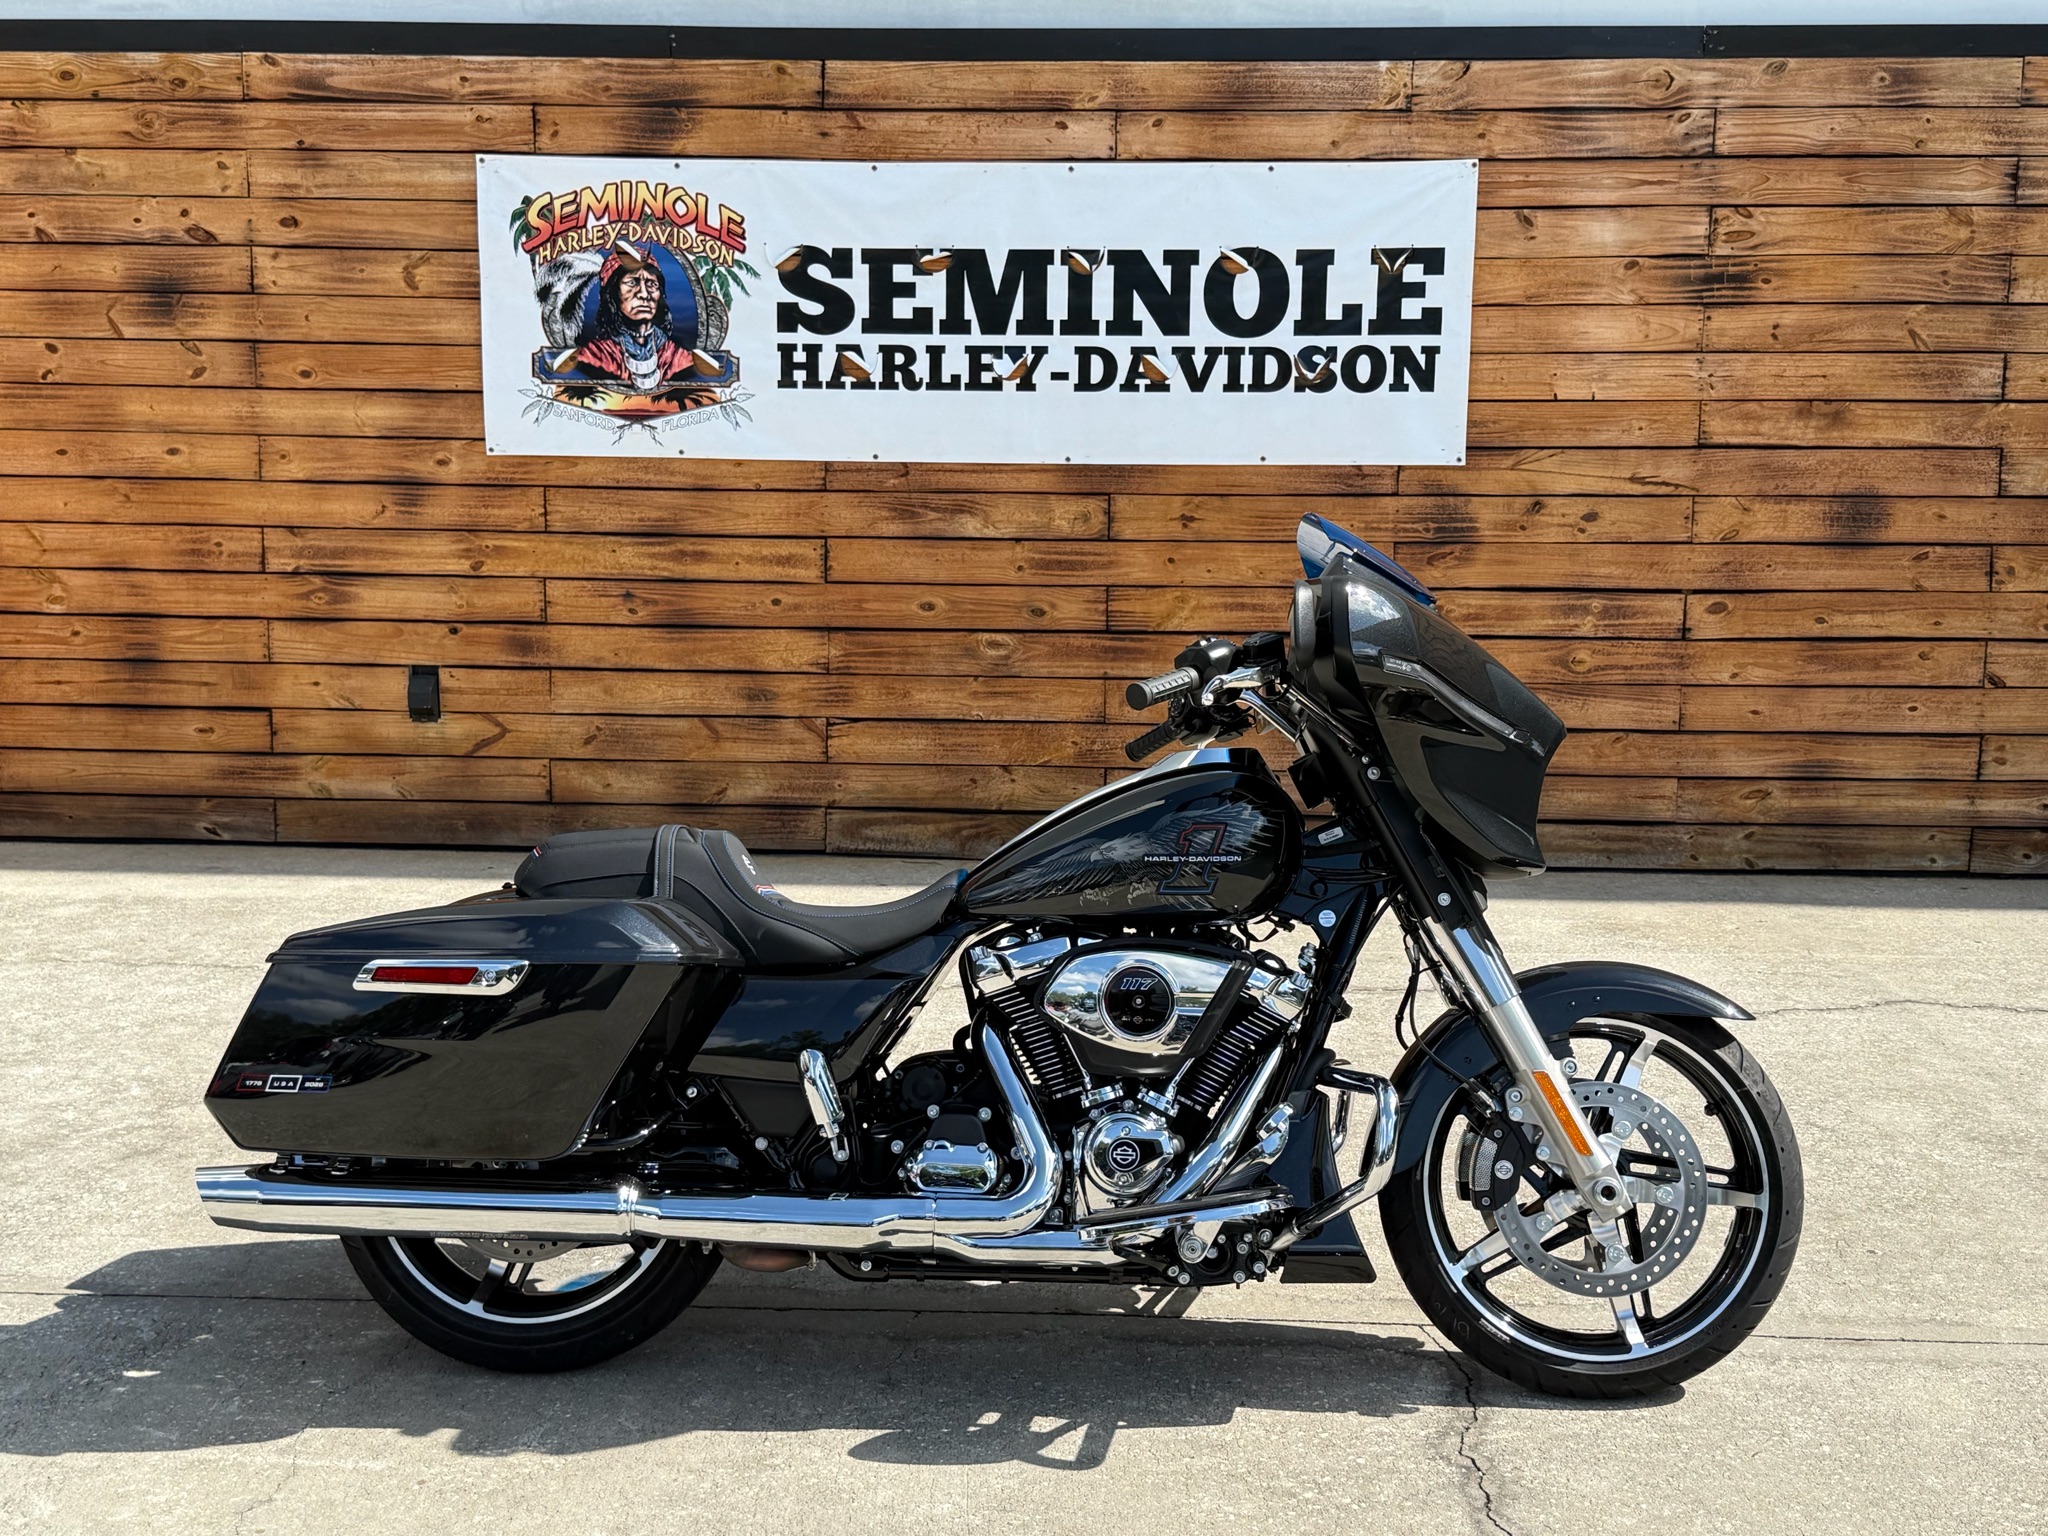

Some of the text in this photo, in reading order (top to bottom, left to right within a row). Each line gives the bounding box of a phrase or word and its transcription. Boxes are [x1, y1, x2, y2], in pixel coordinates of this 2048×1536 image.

[521, 180, 747, 253] SEMINOLE
[537, 222, 735, 267] HARLEY-DAVIDSON
[776, 244, 1446, 339] SEMINOLE
[776, 343, 1441, 394] HARLEY-DAVIDSON
[661, 406, 721, 432] FLORIDA
[1144, 854, 1242, 863] HARLEY-DAVIDSON
[1120, 977, 1158, 991] 117
